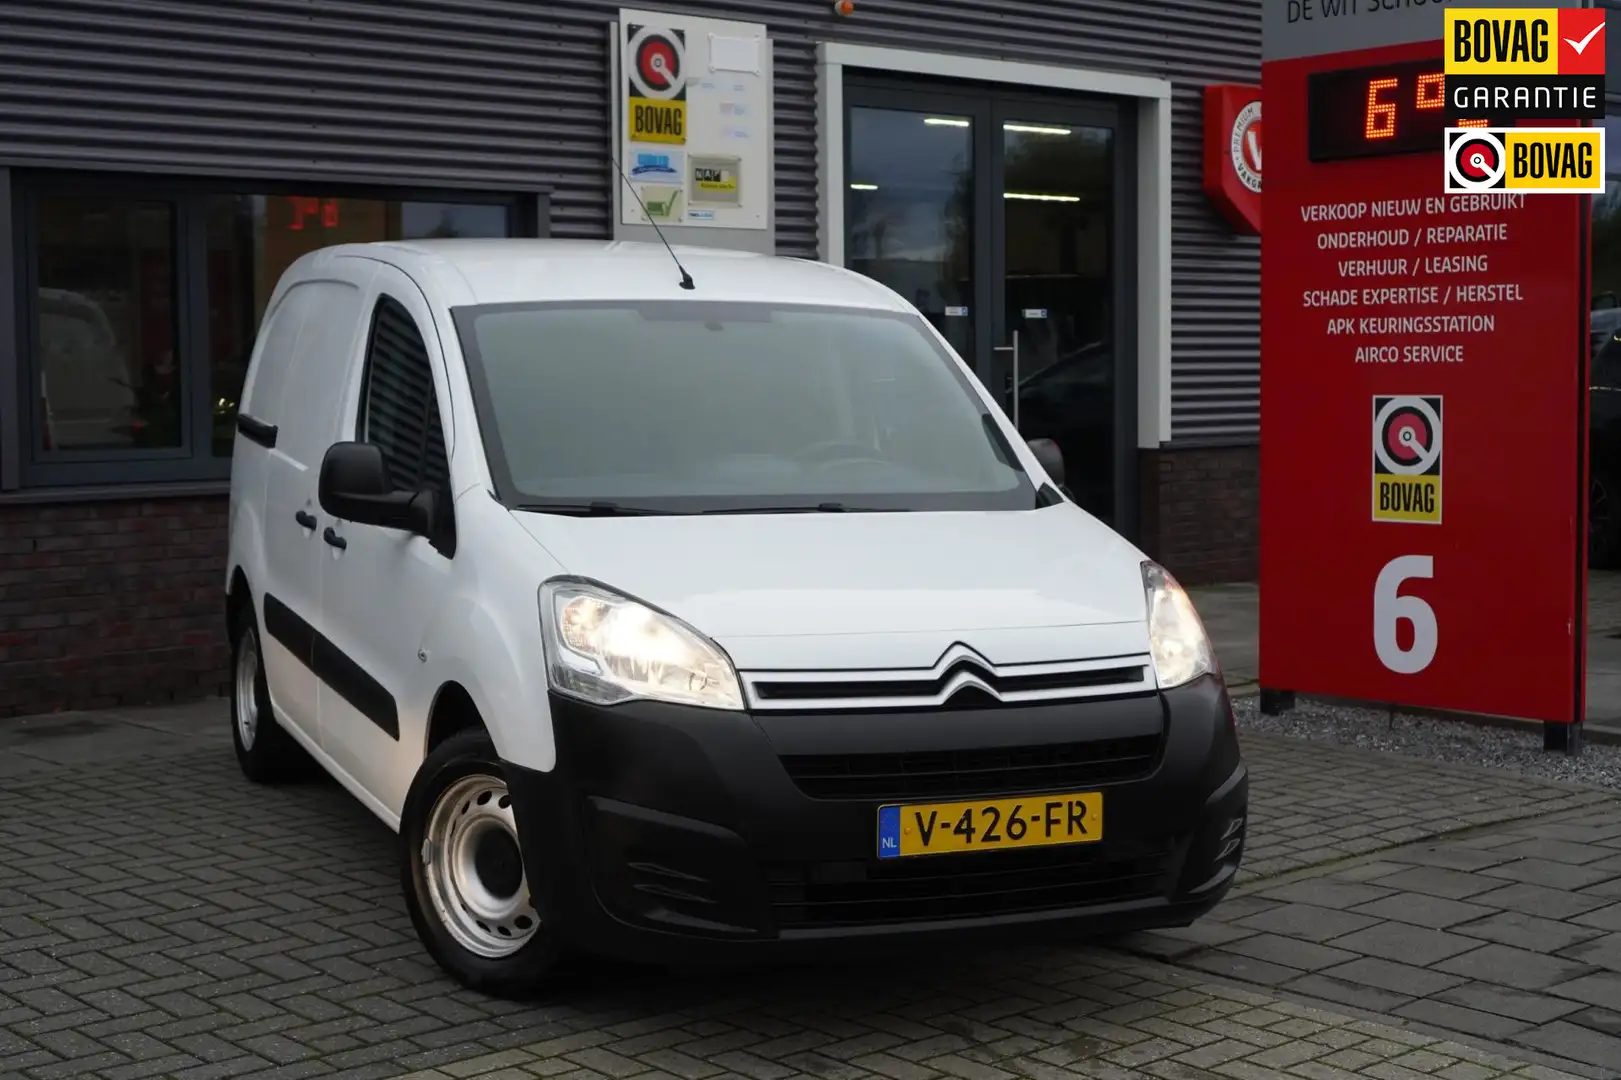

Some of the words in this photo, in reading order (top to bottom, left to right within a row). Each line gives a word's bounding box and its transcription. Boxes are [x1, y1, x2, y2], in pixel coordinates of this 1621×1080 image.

[1287, 0, 1313, 23] DE
[635, 105, 682, 136] BOVAG
[1301, 203, 1367, 221] VERKOOP
[1371, 200, 1421, 217] NIEUW
[1426, 198, 1445, 214] EN
[1450, 193, 1527, 212] GEBRUIKT
[1317, 229, 1409, 249] ONDERHOUD
[1414, 228, 1422, 247] /
[1427, 224, 1507, 243] REPARATIE
[1338, 259, 1407, 276] VERHUUR
[1412, 258, 1420, 276] /
[1425, 255, 1488, 273] LEASING
[1303, 290, 1358, 307] SCHADE
[1363, 287, 1438, 305] EXPERTISE
[1443, 287, 1452, 305] /
[1456, 285, 1523, 302] HERSTEL
[1327, 319, 1355, 335] APK
[1360, 315, 1494, 334] KEURINGSSTATION
[1355, 346, 1398, 363] AIRCO
[1403, 345, 1464, 363] SERVICE
[1380, 482, 1434, 513] BOVAG
[1373, 555, 1438, 674] 6
[882, 838, 897, 848] NL
[915, 801, 1088, 847] V-426-FR
